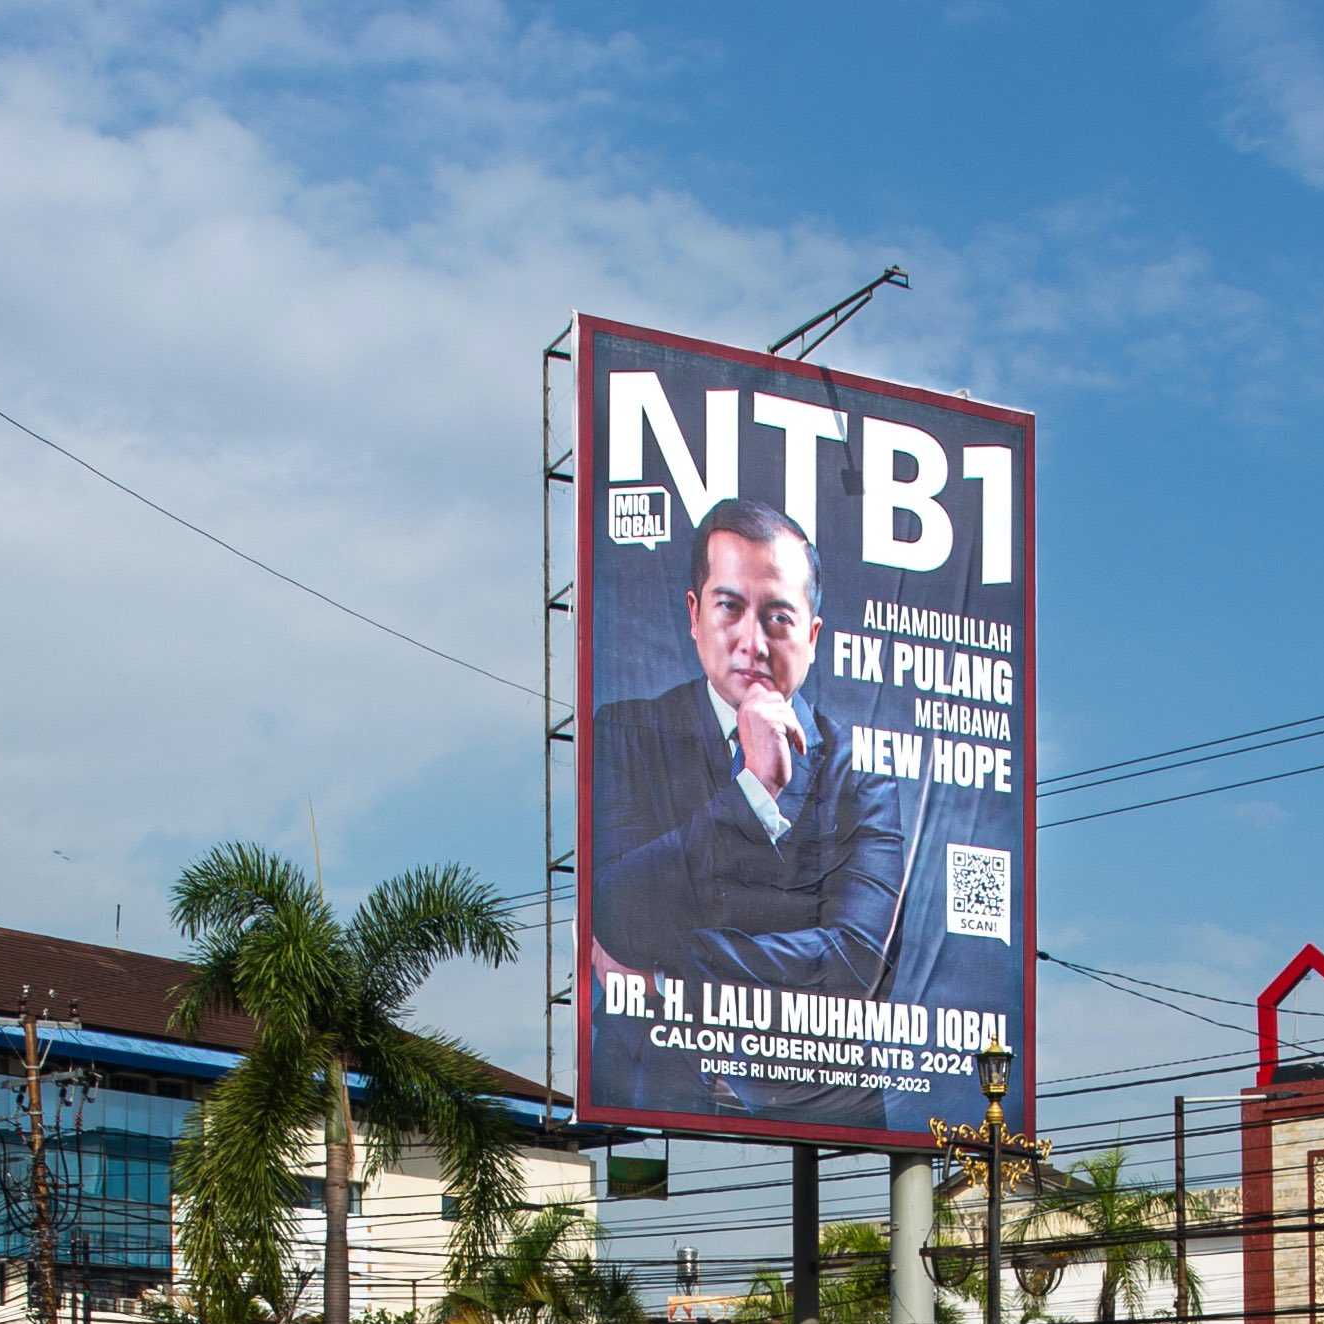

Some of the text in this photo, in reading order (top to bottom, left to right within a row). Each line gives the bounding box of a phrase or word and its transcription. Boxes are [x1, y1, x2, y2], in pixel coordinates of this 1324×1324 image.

[609, 370, 1012, 584] NTB1
[615, 514, 665, 538] IQBAL
[616, 495, 649, 517] MIQ
[864, 600, 1012, 653] ALHAMDULILLAH
[833, 631, 1013, 705] FIX PULANG
[915, 698, 1011, 742] MEMBAWA
[852, 726, 1012, 793] NEW HOPE
[959, 917, 998, 933] SCAN!
[605, 971, 1012, 1053] DR. H. LALU MUHAMAD IQBAL
[650, 1025, 974, 1076] CALON GUBERNUR NTB 2024
[700, 1058, 930, 1094] DUBES RI UNTUK TURKI 2019-2023
